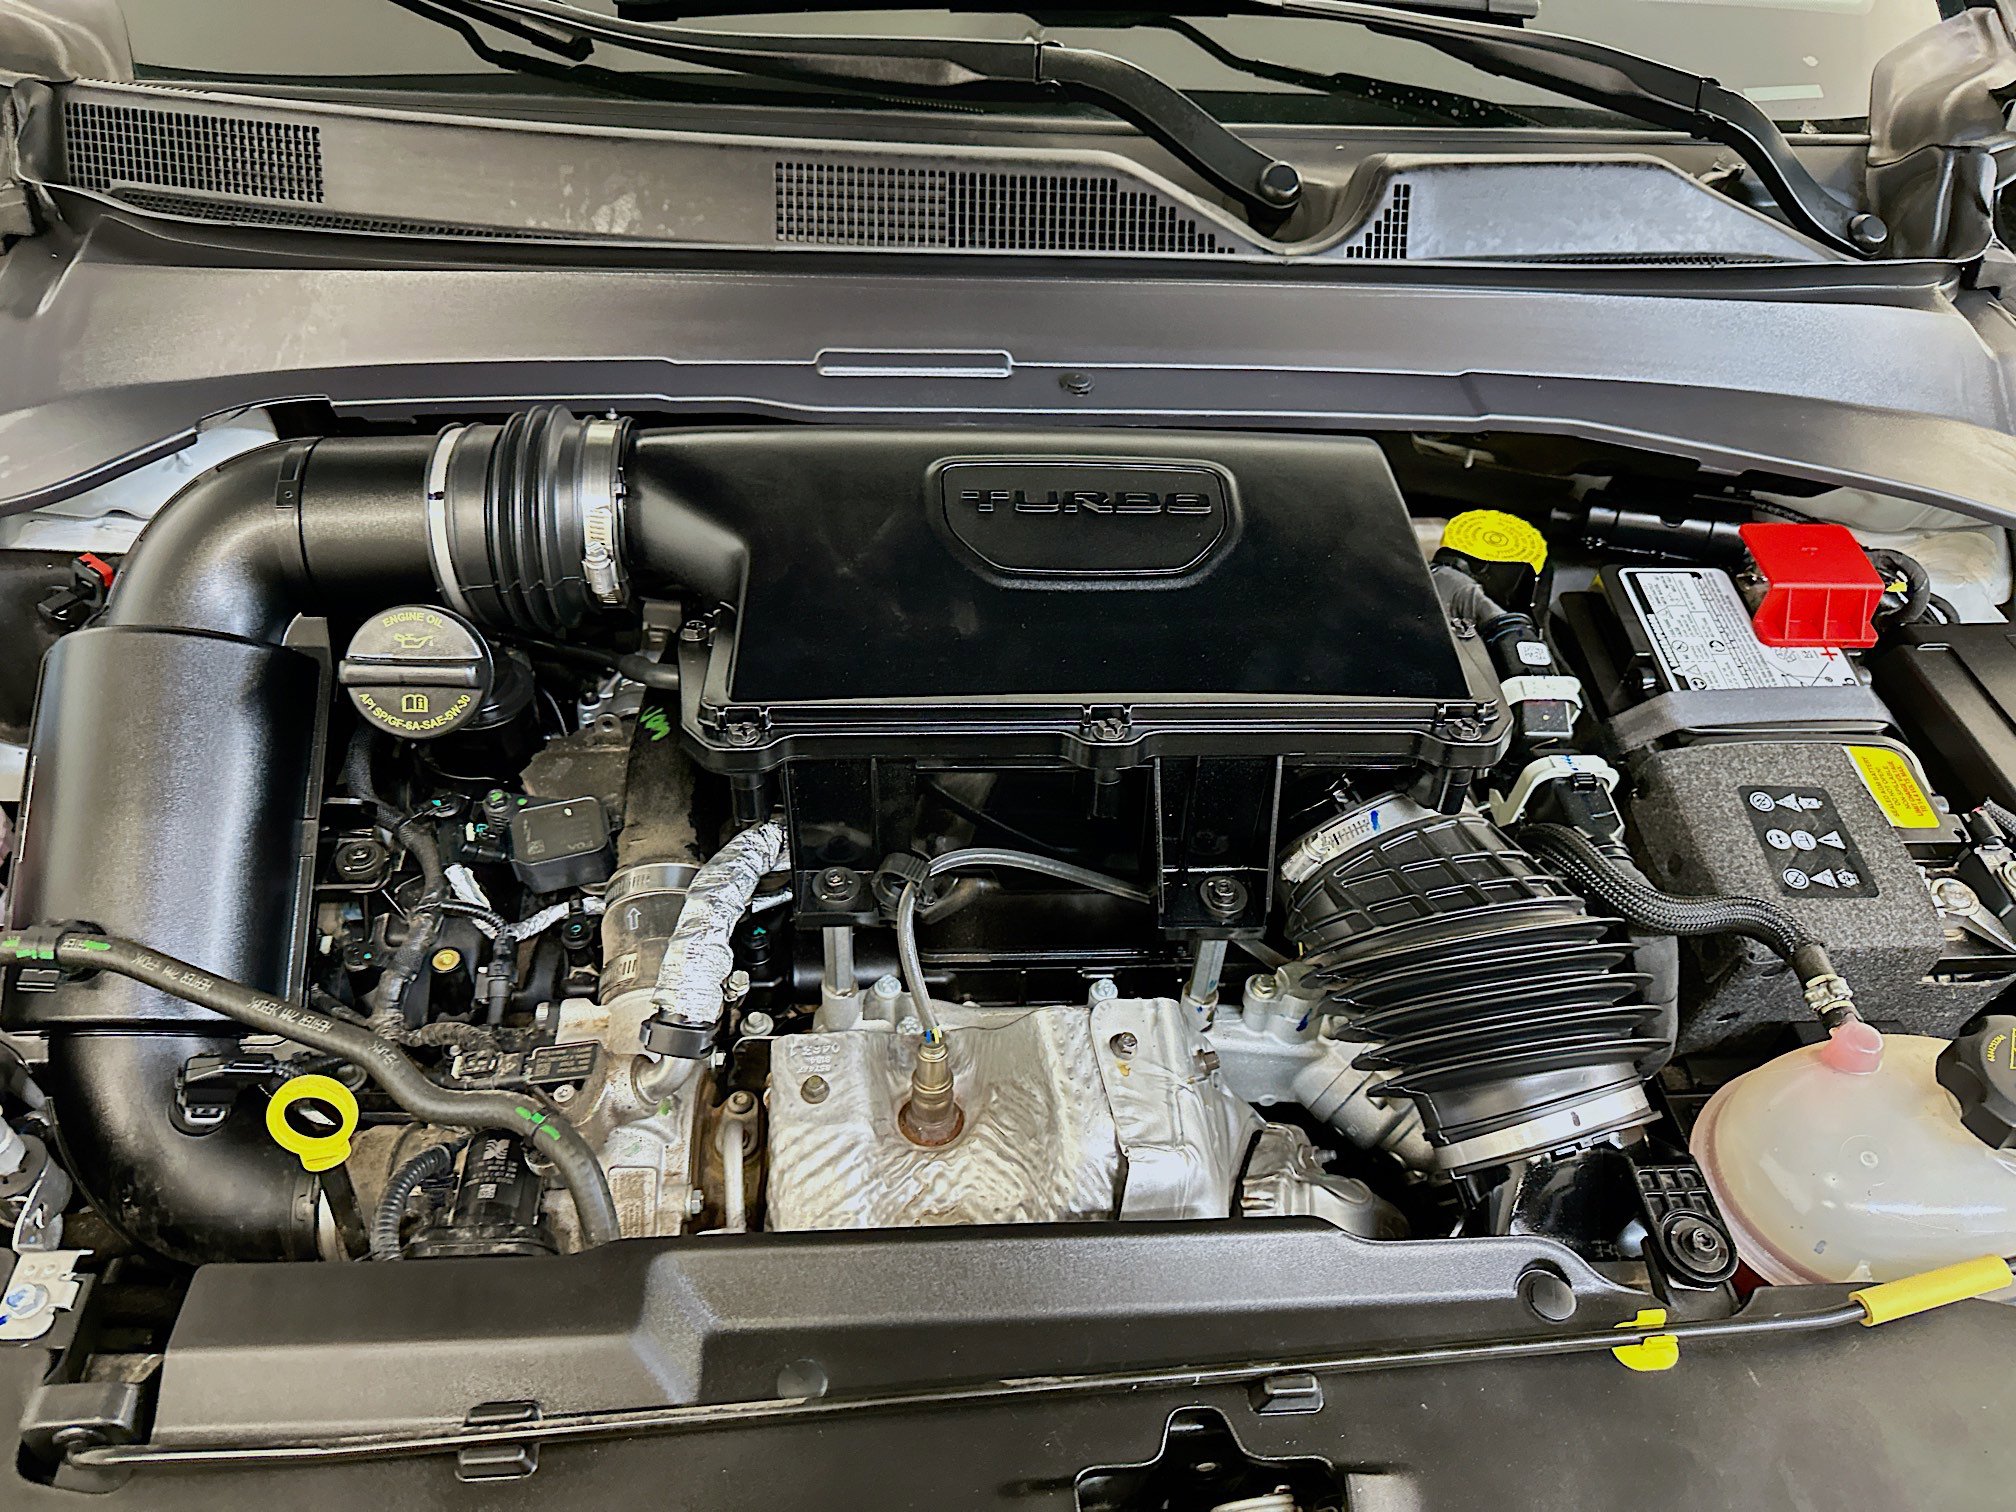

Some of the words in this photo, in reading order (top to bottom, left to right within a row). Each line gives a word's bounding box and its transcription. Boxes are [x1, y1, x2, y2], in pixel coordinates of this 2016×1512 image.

[960, 490, 1212, 514] TURBO
[382, 612, 425, 628] ENGINE
[426, 614, 444, 629] OIL
[359, 693, 377, 709] API
[180, 973, 213, 992] HEATER
[297, 1013, 334, 1034] HEATER
